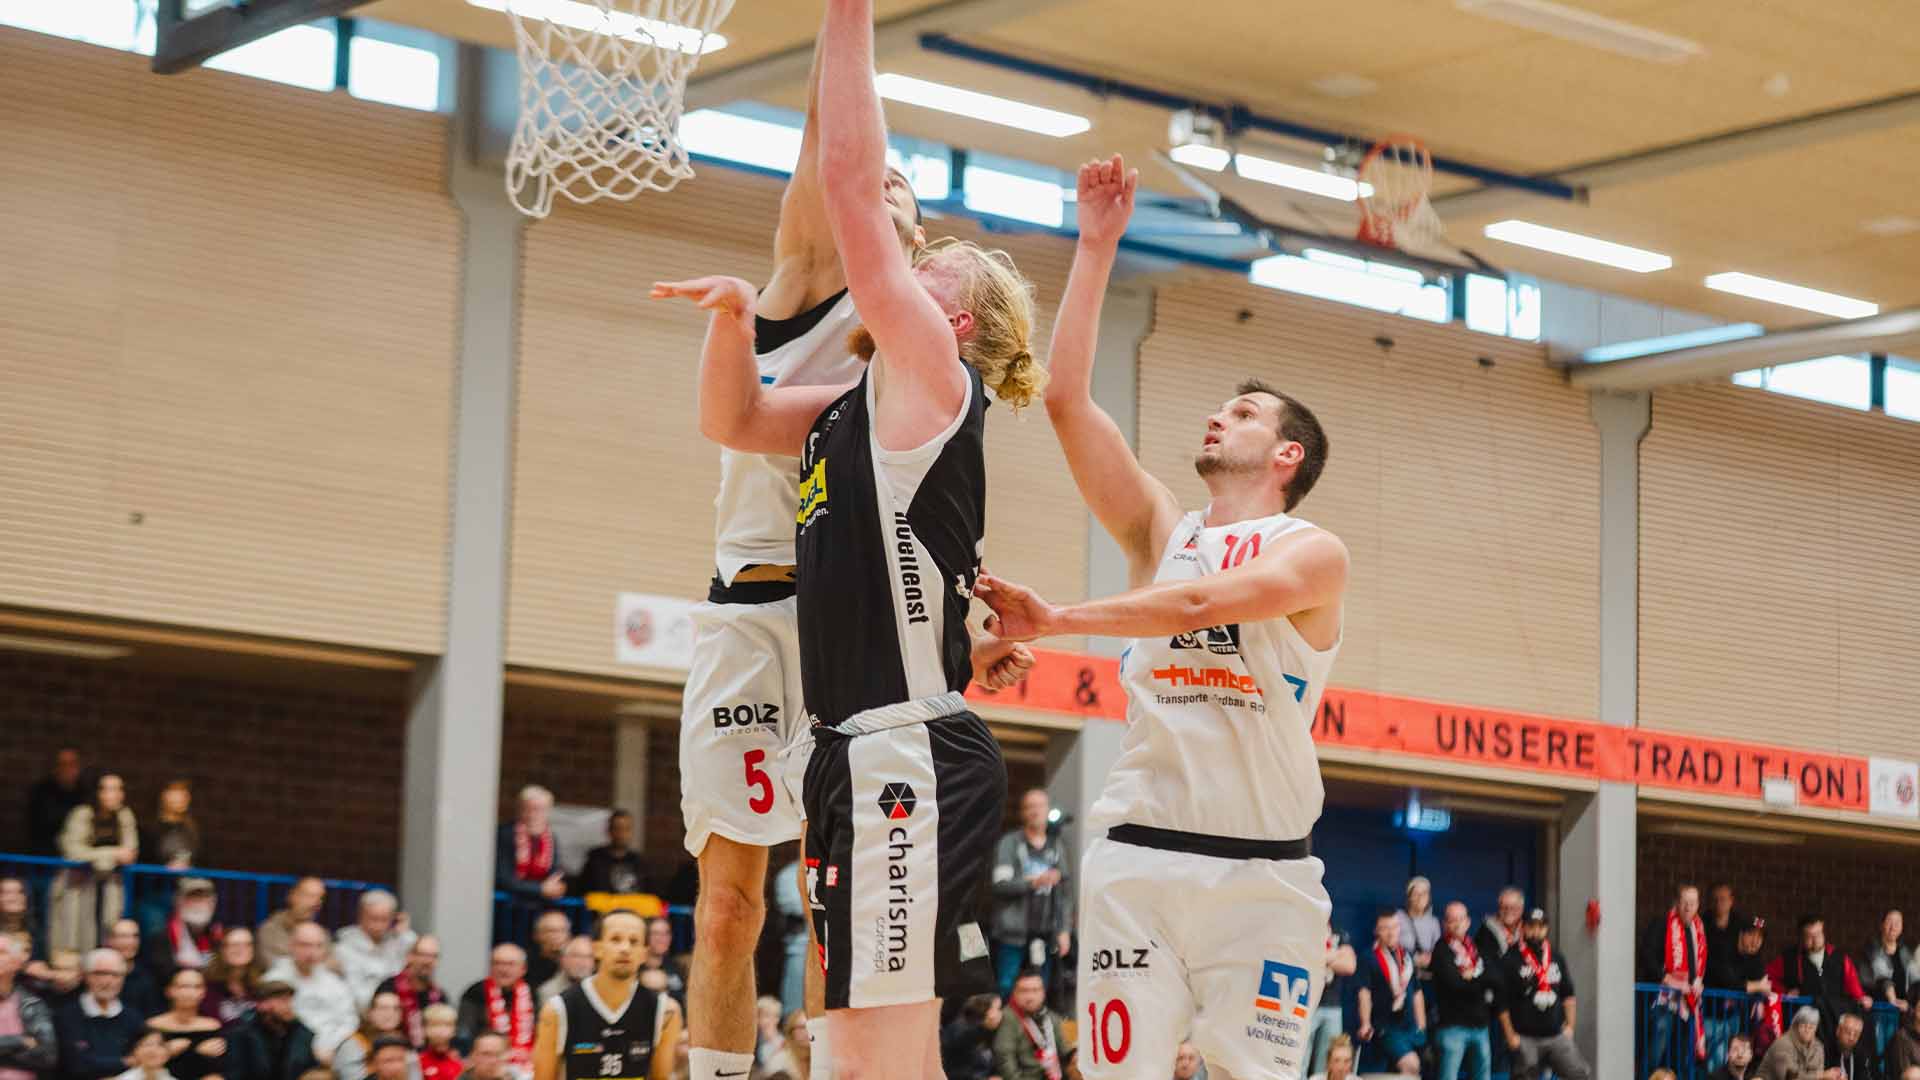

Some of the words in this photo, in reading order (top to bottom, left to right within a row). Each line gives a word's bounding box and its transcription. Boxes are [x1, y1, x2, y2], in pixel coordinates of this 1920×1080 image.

[1221, 532, 1262, 571] 10
[713, 704, 780, 728] BOLZ
[1156, 694, 1209, 706] Transporte
[1076, 667, 1098, 706] &
[1435, 714, 1596, 771] UNSERE
[1627, 738, 1864, 804] TRADITION!
[743, 749, 775, 815] 5
[888, 827, 914, 972] charisma
[1092, 949, 1149, 971] BOLZ
[1088, 998, 1132, 1065] 10
